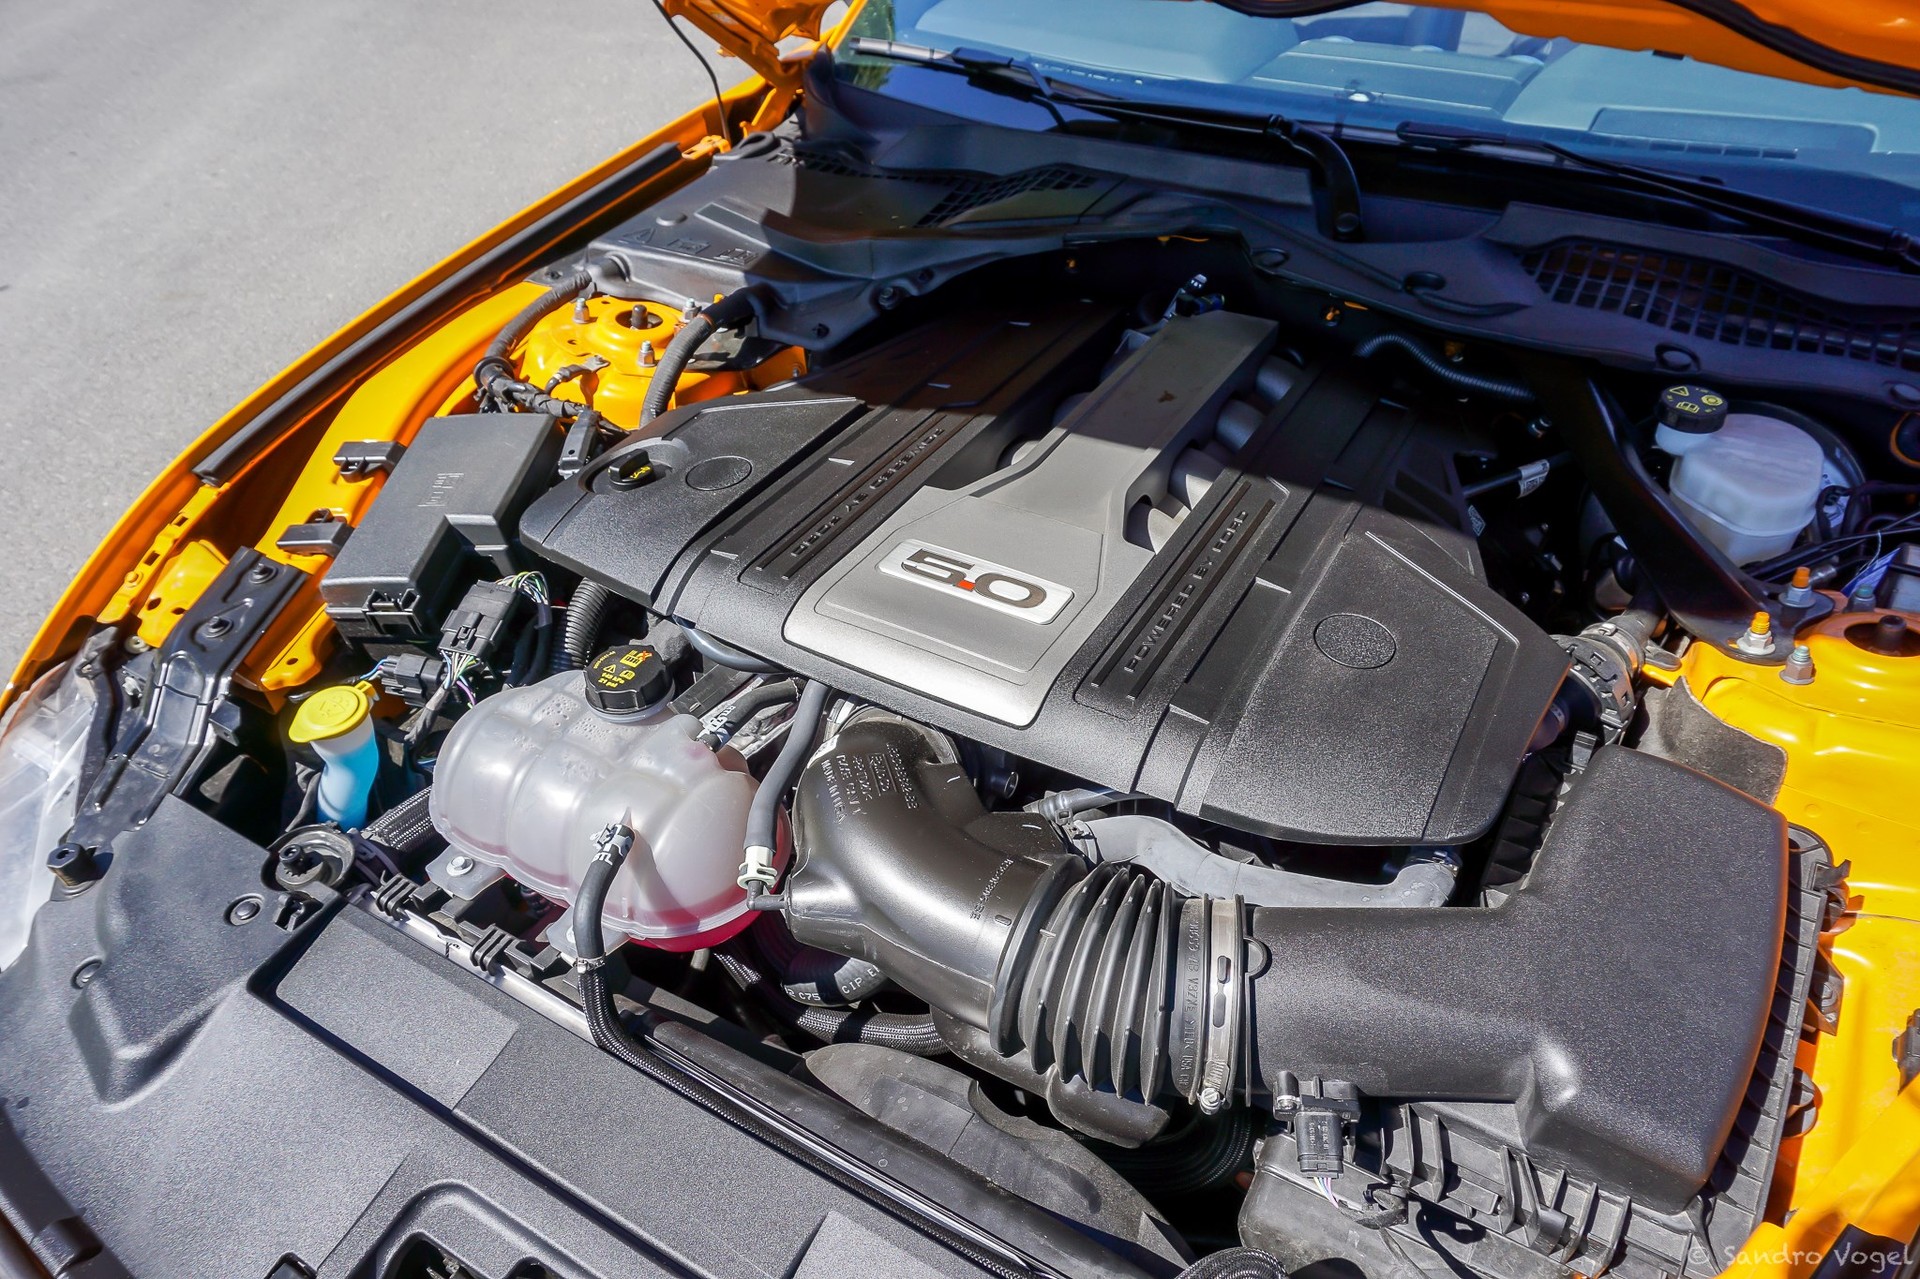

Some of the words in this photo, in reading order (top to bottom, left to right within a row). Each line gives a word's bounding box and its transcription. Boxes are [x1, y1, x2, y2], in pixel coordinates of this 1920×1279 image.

[845, 493, 869, 512] BY
[901, 548, 1047, 609] 5.0
[1124, 583, 1196, 673] POWERED
[1192, 556, 1214, 579] BY
[1212, 511, 1249, 553] FORD
[821, 759, 836, 785] MADE
[829, 784, 840, 798] IN
[832, 796, 847, 824] USA
[1180, 1054, 1194, 1071] USA
